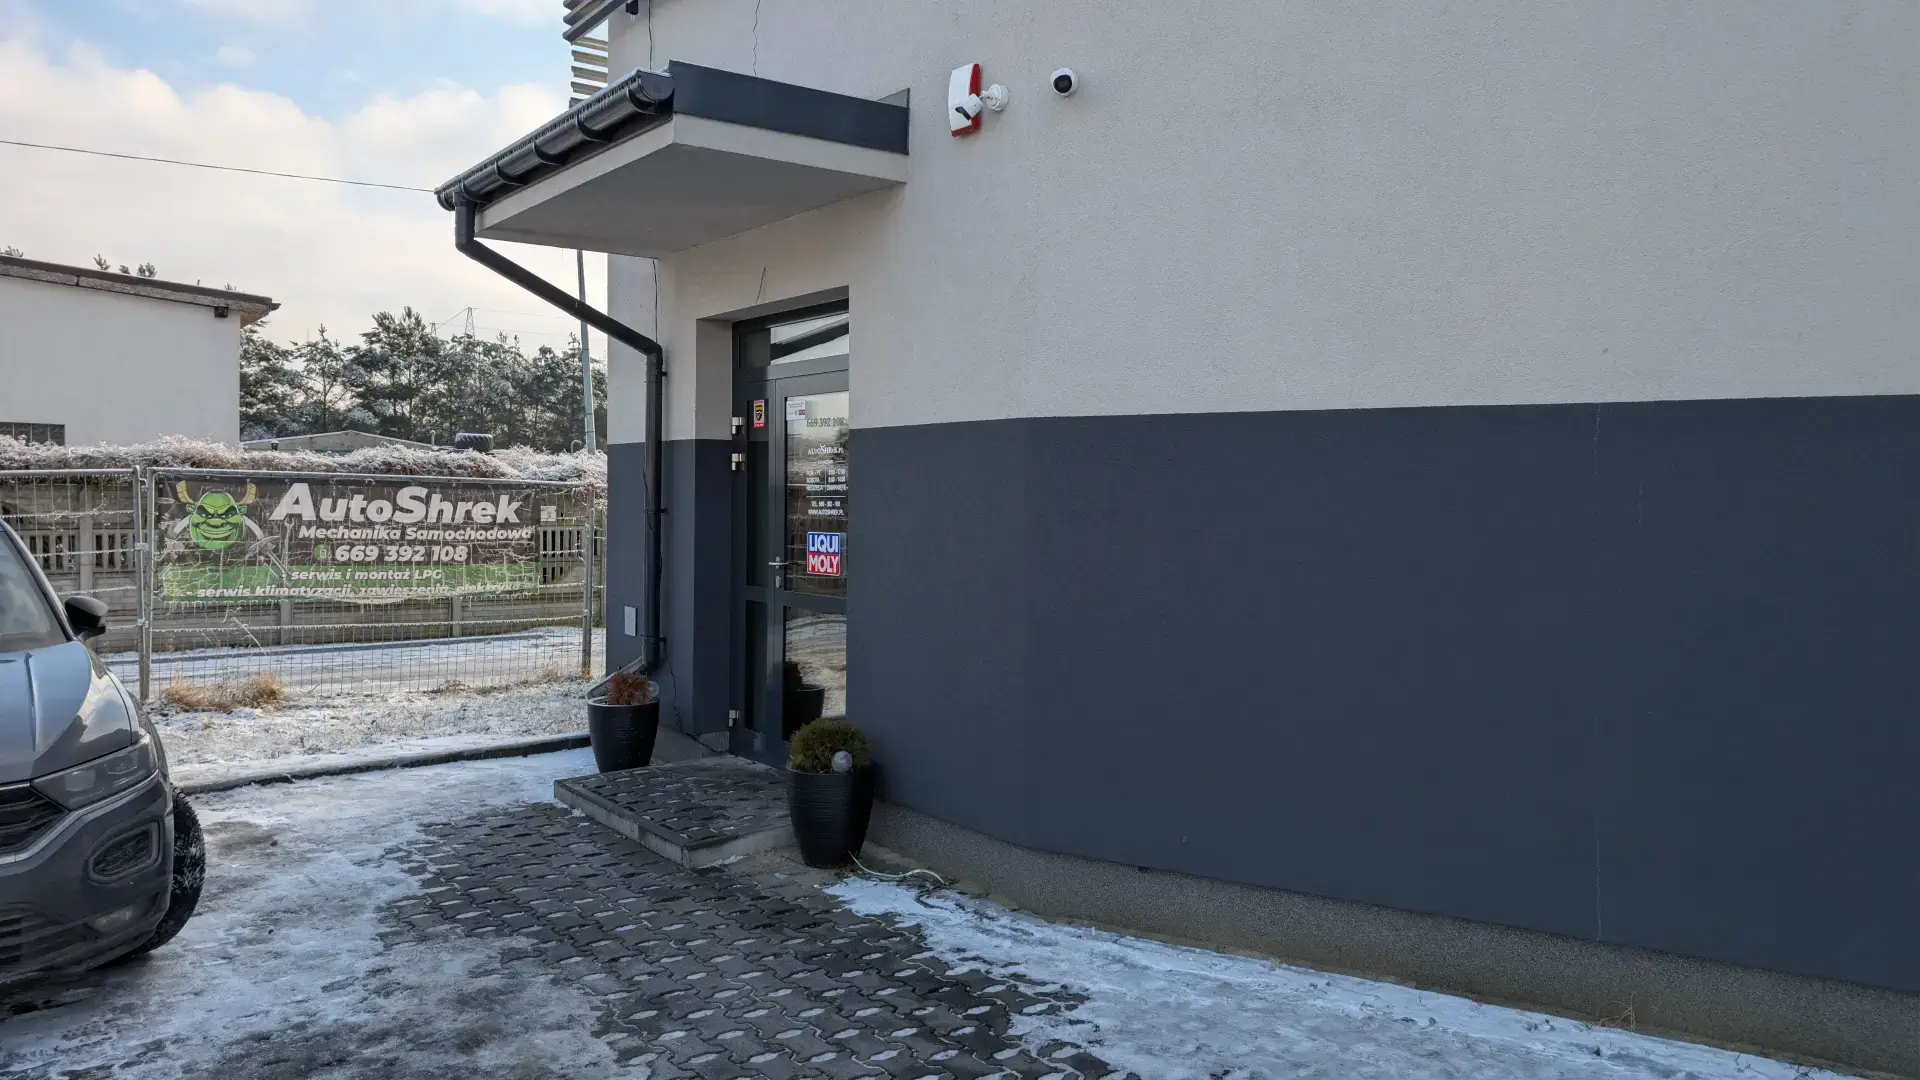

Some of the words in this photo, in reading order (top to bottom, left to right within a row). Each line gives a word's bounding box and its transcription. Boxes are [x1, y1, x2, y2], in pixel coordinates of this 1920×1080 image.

[268, 482, 524, 523] AutoShrek
[298, 525, 402, 540] Mechanika
[405, 526, 532, 541] Samochodowa
[809, 534, 839, 553] LIQUI
[335, 545, 380, 562] 669
[383, 545, 426, 563] 392
[431, 545, 469, 562] 108
[808, 554, 839, 573] MOLY
[291, 568, 340, 580] serwis
[345, 568, 352, 580] i
[354, 568, 411, 580] montaż
[414, 569, 443, 580] LPG
[197, 585, 251, 598] serwis
